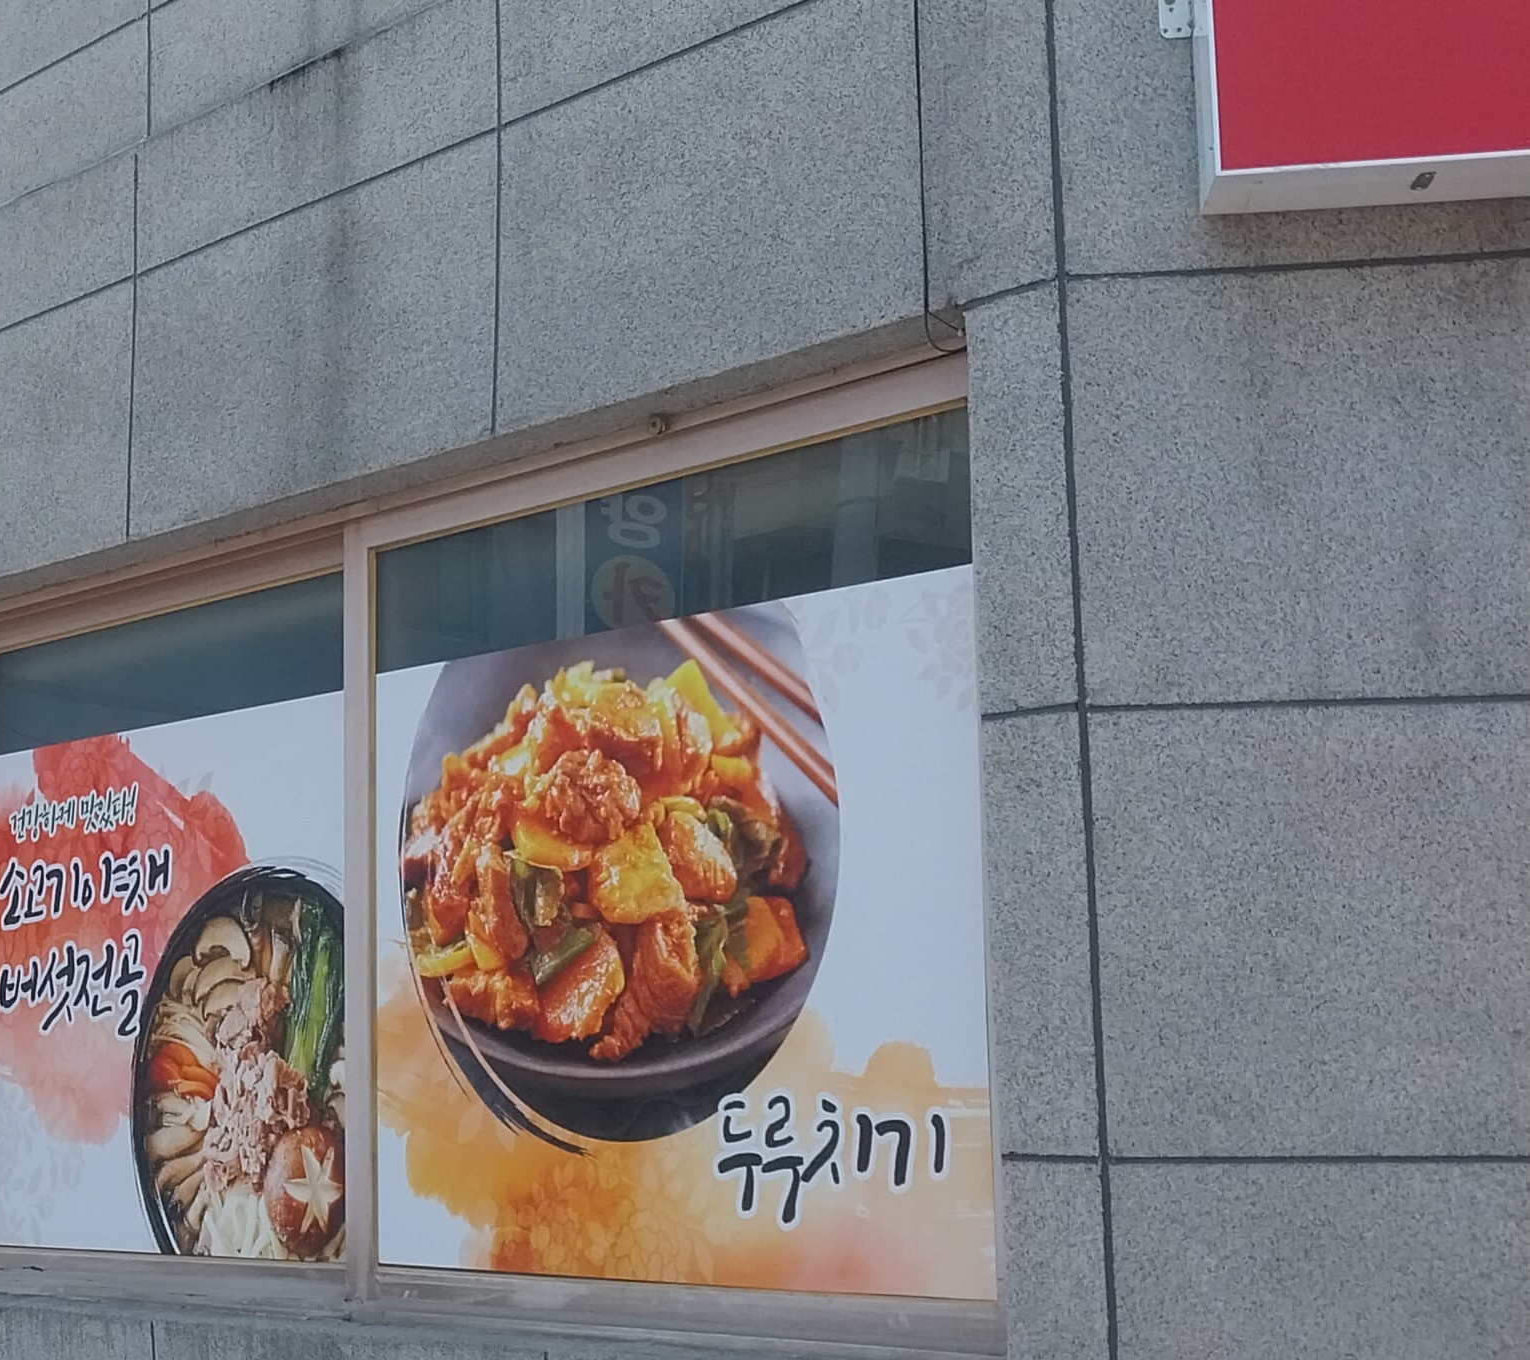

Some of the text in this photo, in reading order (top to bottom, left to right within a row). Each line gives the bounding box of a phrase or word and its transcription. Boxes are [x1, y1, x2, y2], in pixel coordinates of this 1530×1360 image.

[11, 784, 137, 840] 건강하게 맛있다!
[0, 933, 144, 1036] 버섯전골
[718, 1095, 945, 1223] 두루치기
